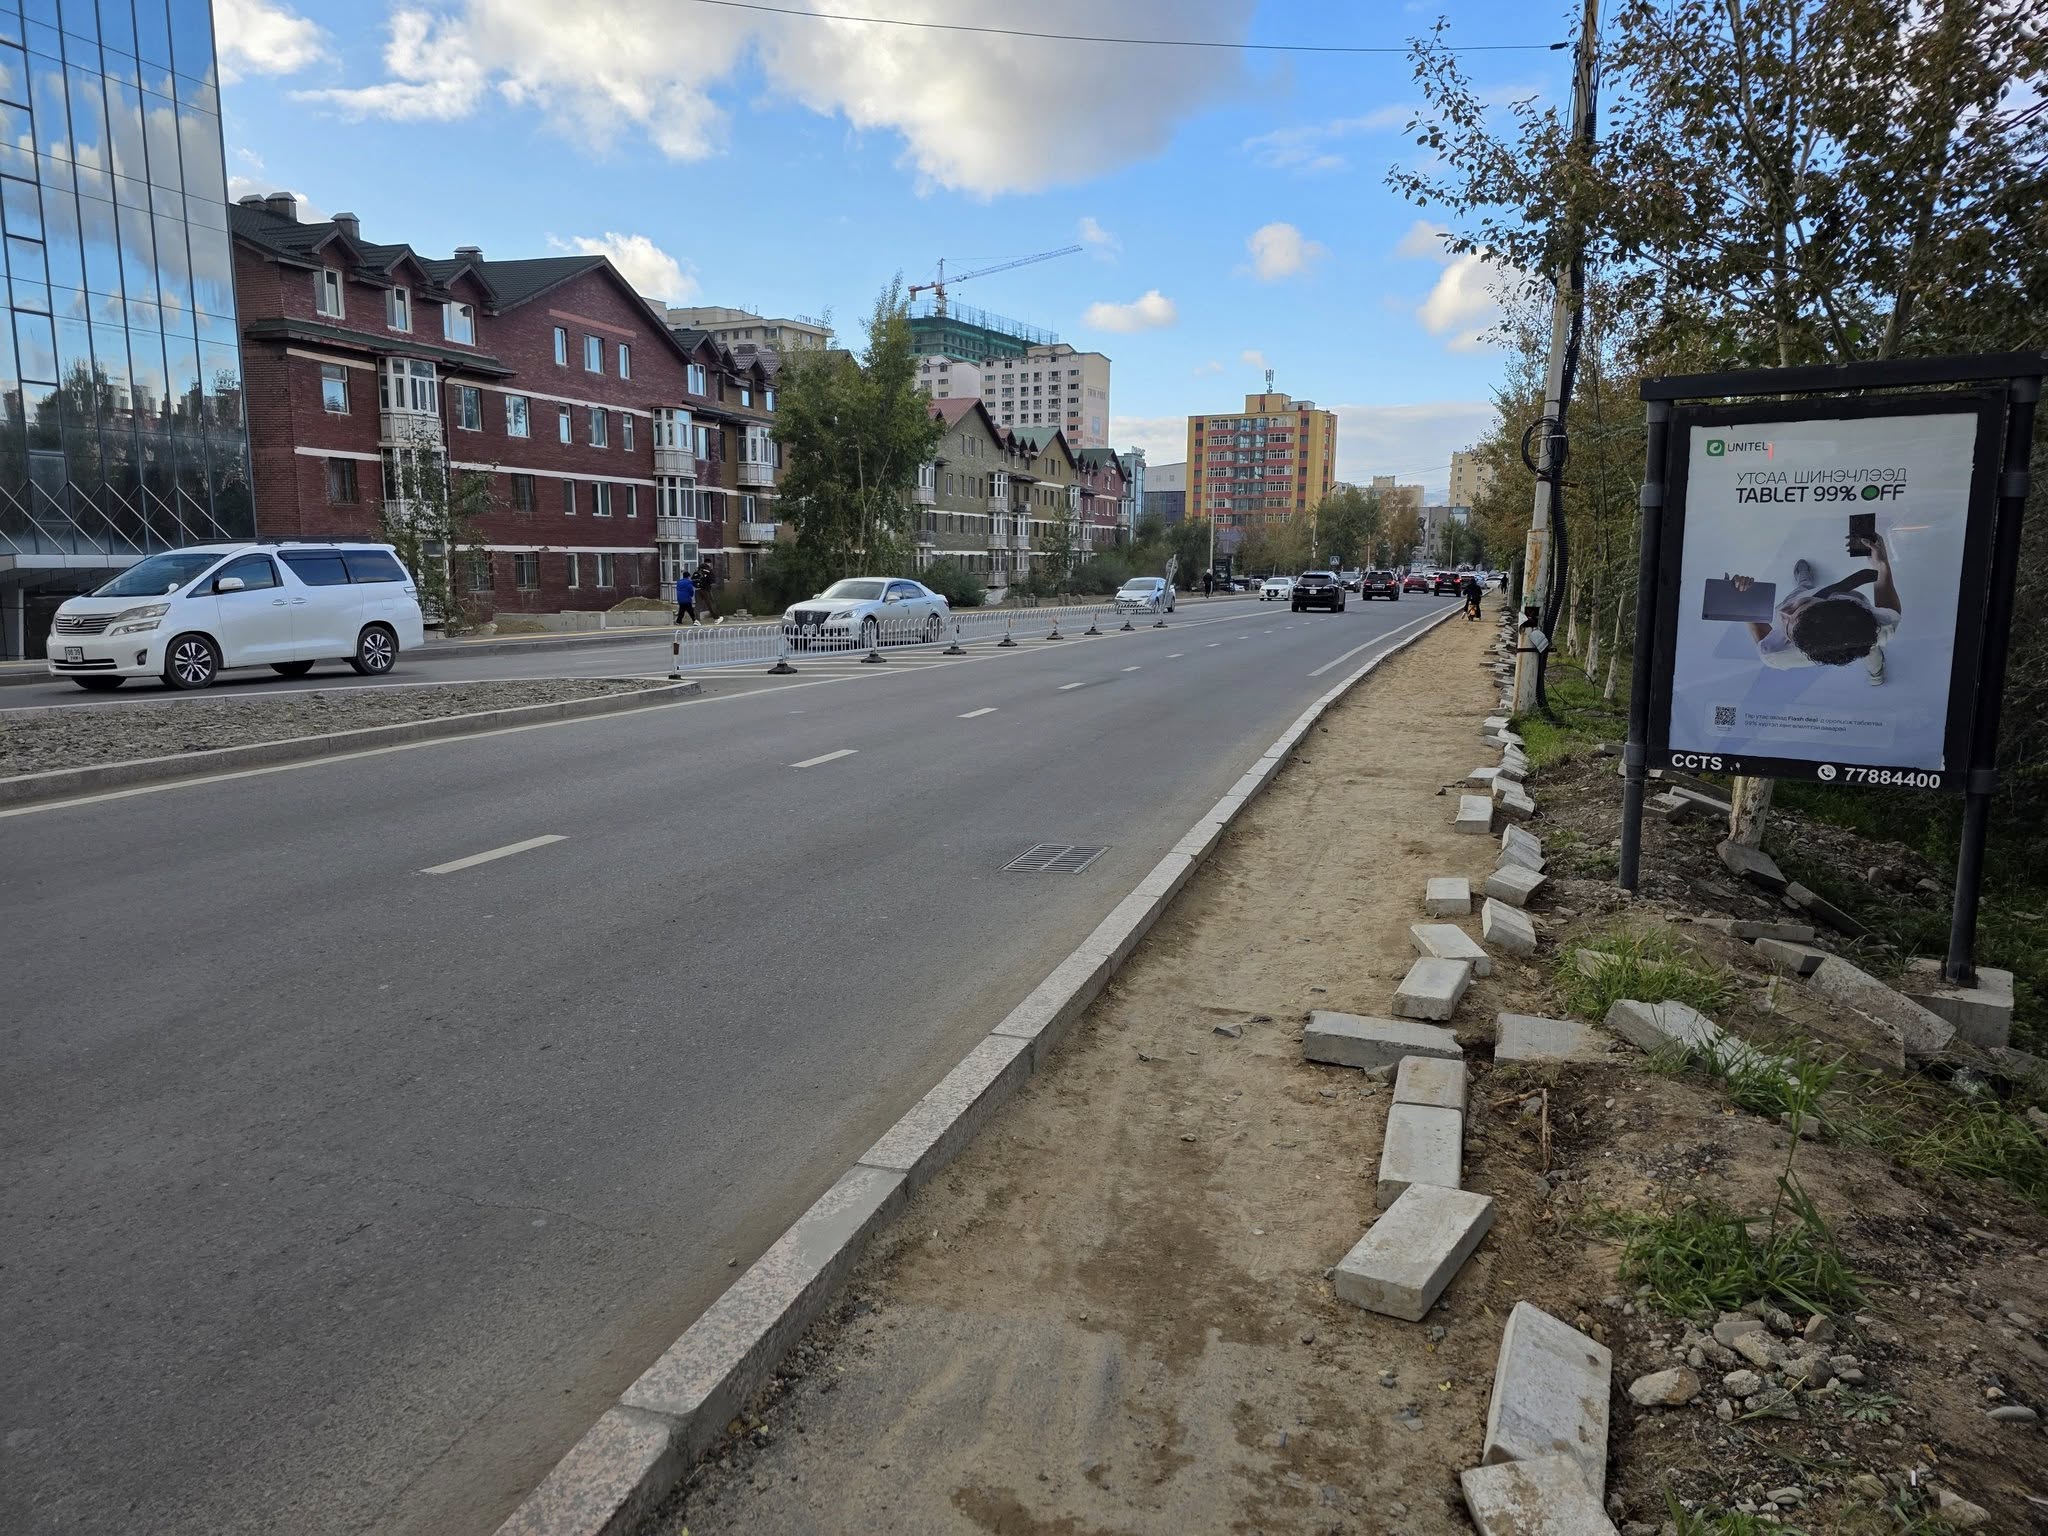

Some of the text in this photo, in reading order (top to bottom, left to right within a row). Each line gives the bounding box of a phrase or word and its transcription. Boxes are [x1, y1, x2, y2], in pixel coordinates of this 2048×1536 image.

[1727, 441, 1769, 453] UNITEL
[1736, 467, 1908, 486] УТСАА ШИНЭЧЛЭЭД
[1736, 484, 1906, 504] TABLET 99% OFF
[1671, 753, 1723, 771] CCTS
[1844, 767, 1941, 789] 77884400
